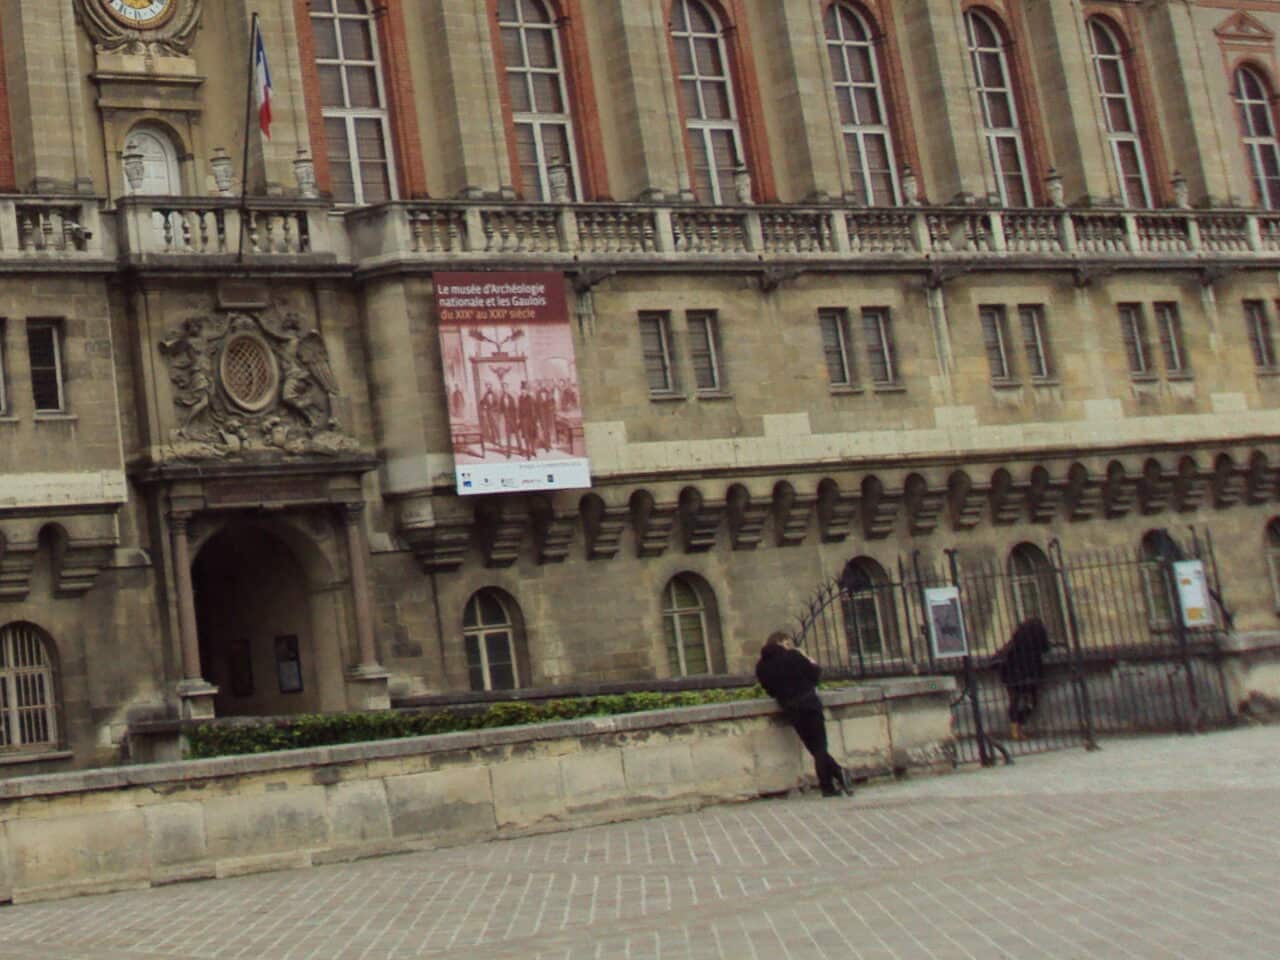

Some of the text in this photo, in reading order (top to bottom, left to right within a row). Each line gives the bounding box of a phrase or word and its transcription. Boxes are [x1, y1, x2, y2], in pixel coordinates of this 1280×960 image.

[437, 282, 545, 296] Le musée d'Archéologie
[439, 296, 546, 307] nationale et les Gaulois
[440, 309, 453, 320] du
[475, 311, 488, 320] au
